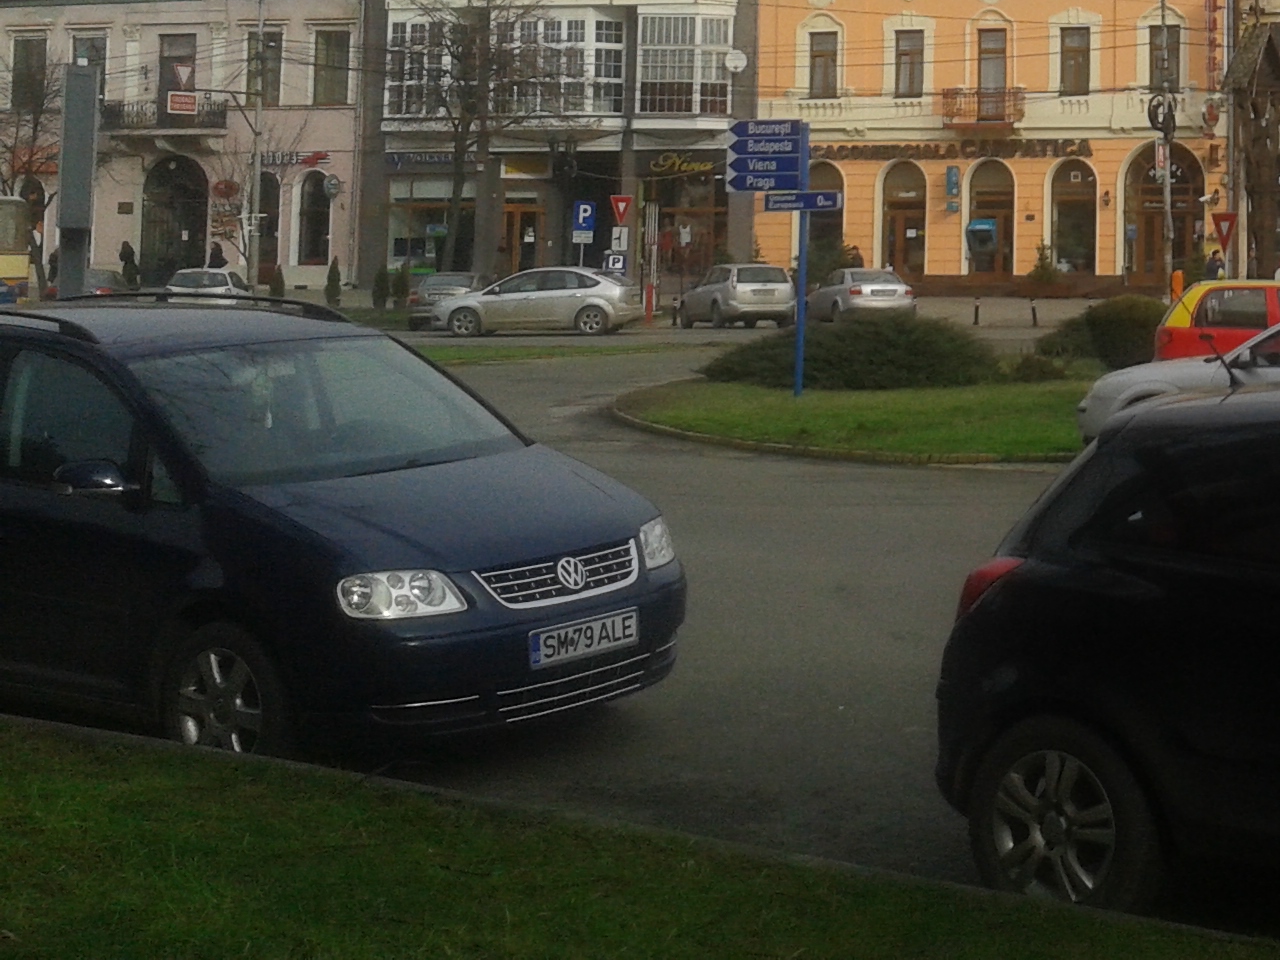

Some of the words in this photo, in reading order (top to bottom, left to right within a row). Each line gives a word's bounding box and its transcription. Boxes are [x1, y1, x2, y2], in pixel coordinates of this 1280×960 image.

[748, 140, 792, 154] Budapesta
[747, 159, 777, 170] Viena
[746, 175, 775, 189] Praga
[579, 204, 592, 224] P
[612, 257, 621, 267] P
[597, 615, 634, 646] ALE
